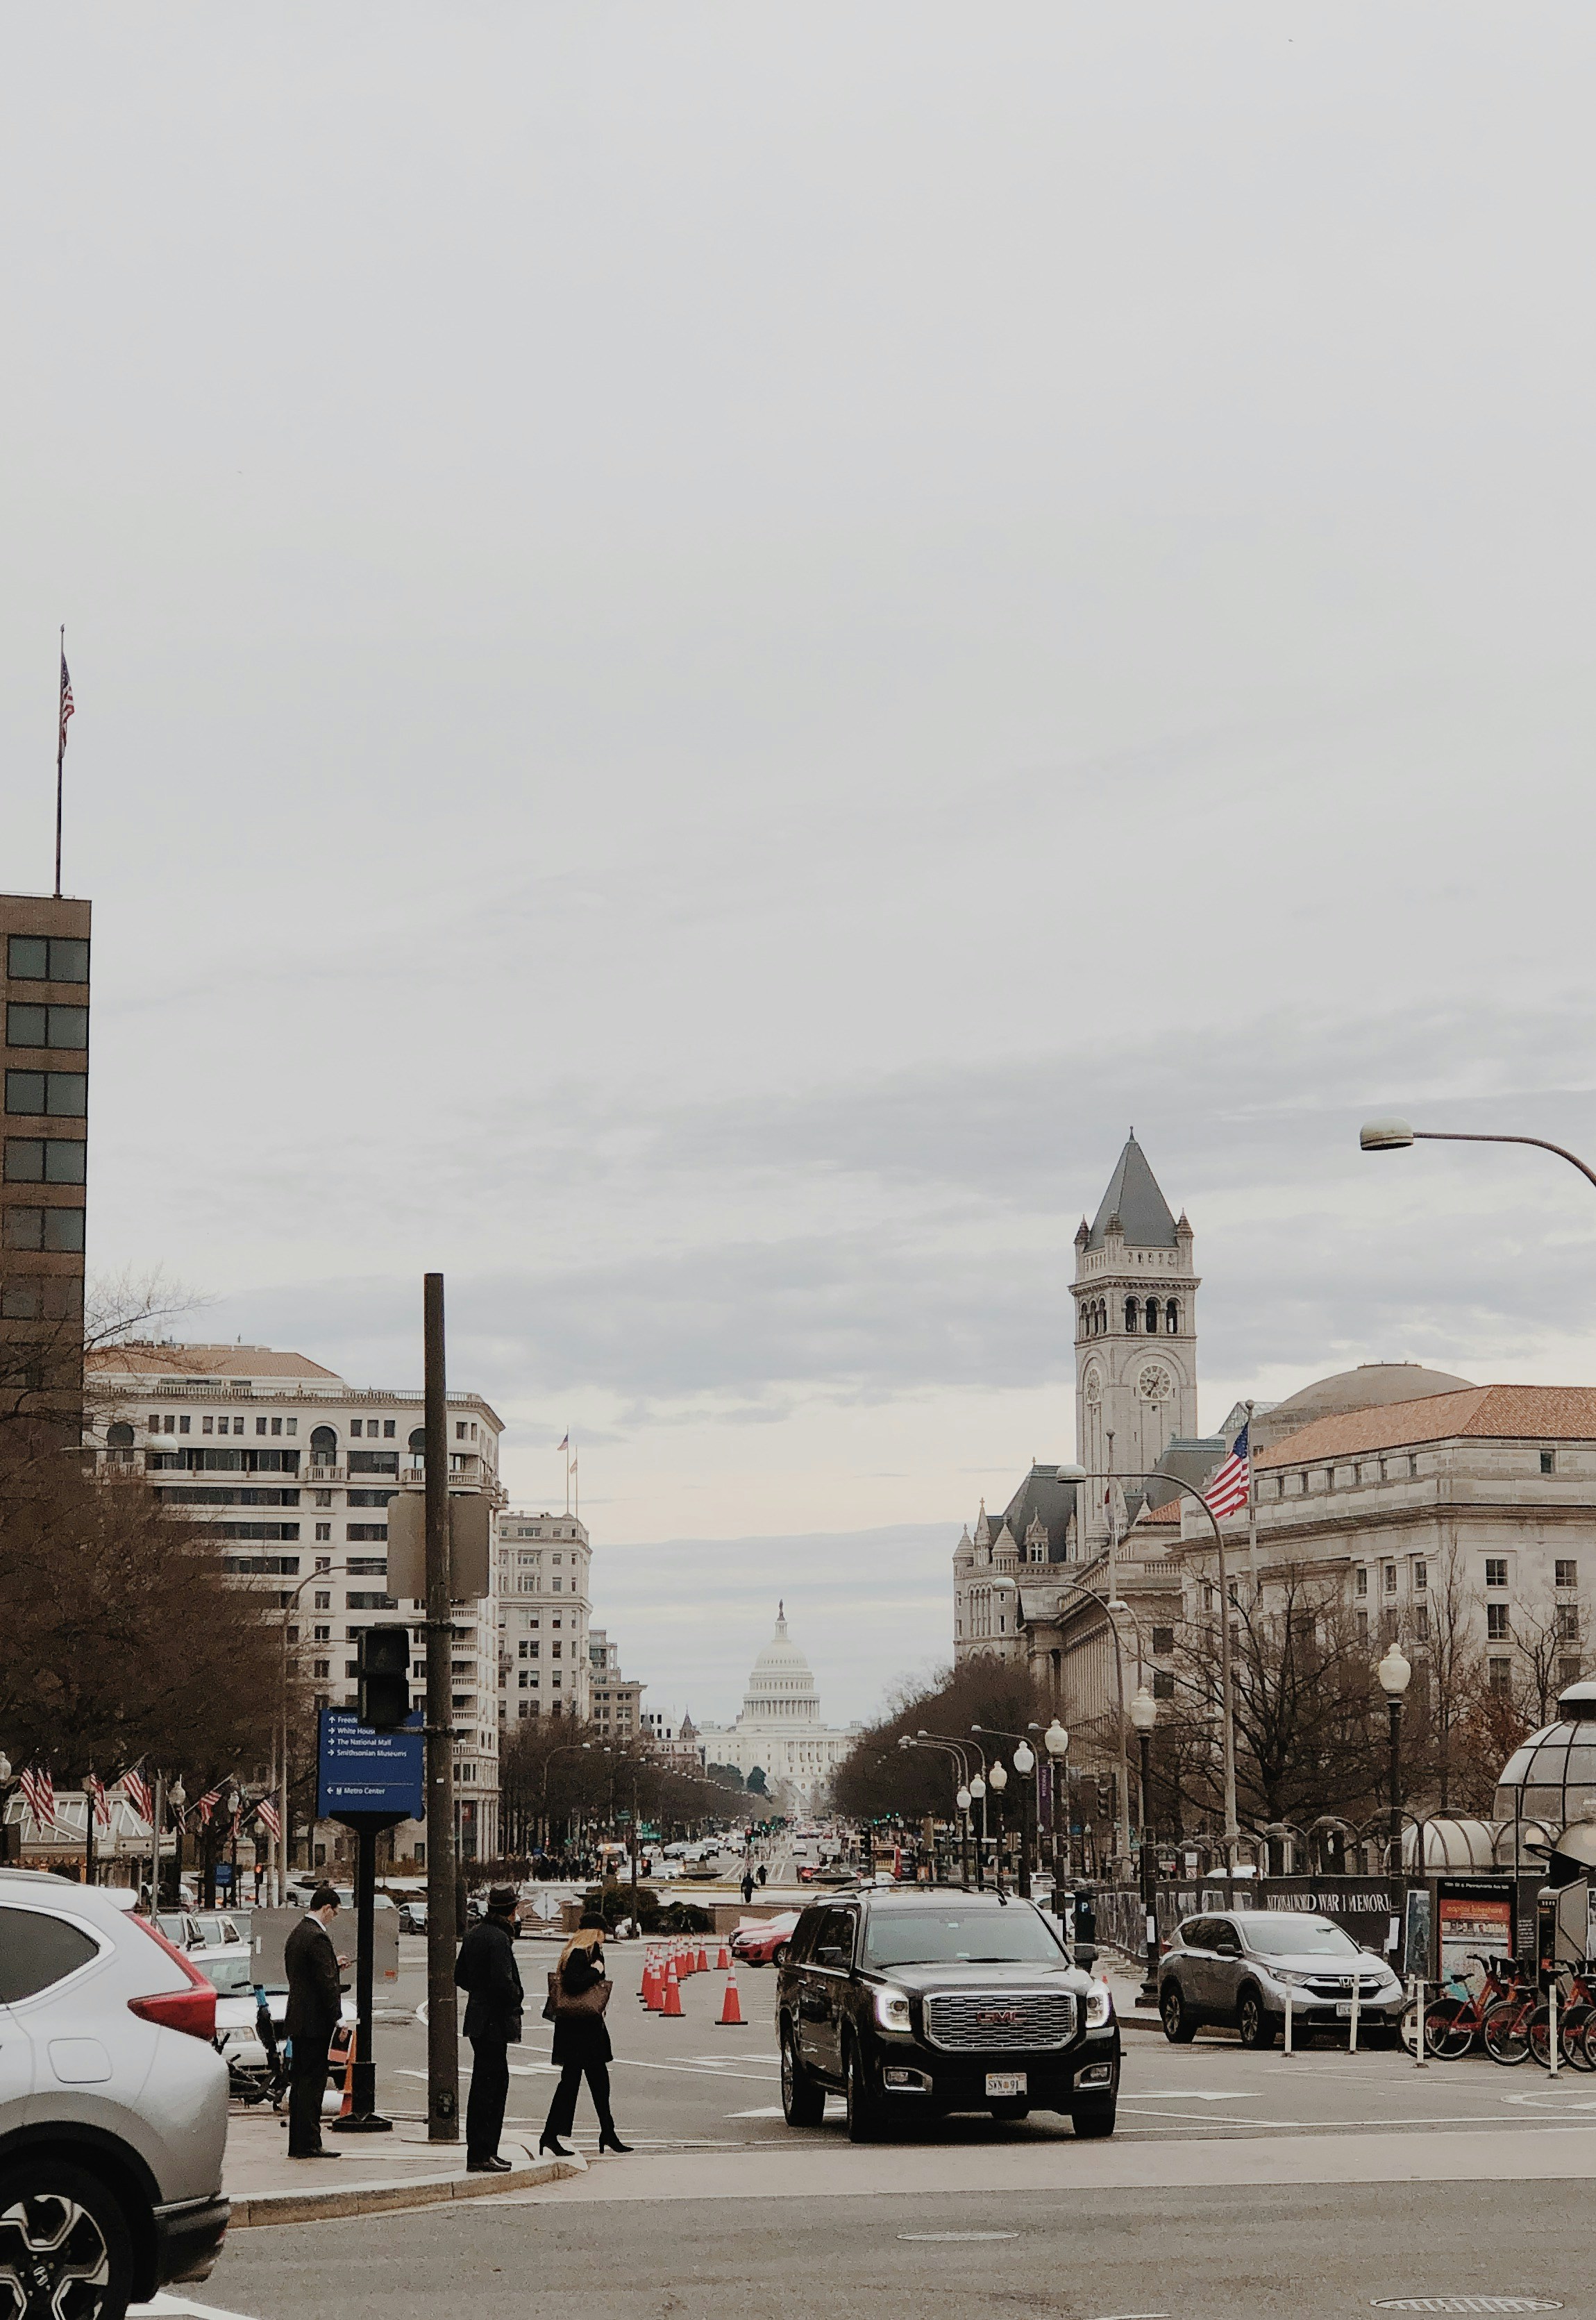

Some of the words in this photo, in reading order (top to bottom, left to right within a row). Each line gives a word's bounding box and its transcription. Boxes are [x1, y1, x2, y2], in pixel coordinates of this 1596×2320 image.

[364, 1787, 385, 1795] Center
[1081, 1902, 1089, 1913] P
[1318, 1894, 1340, 1912] WAR
[1342, 1894, 1347, 1912] I
[977, 2010, 1027, 2024] GMC
